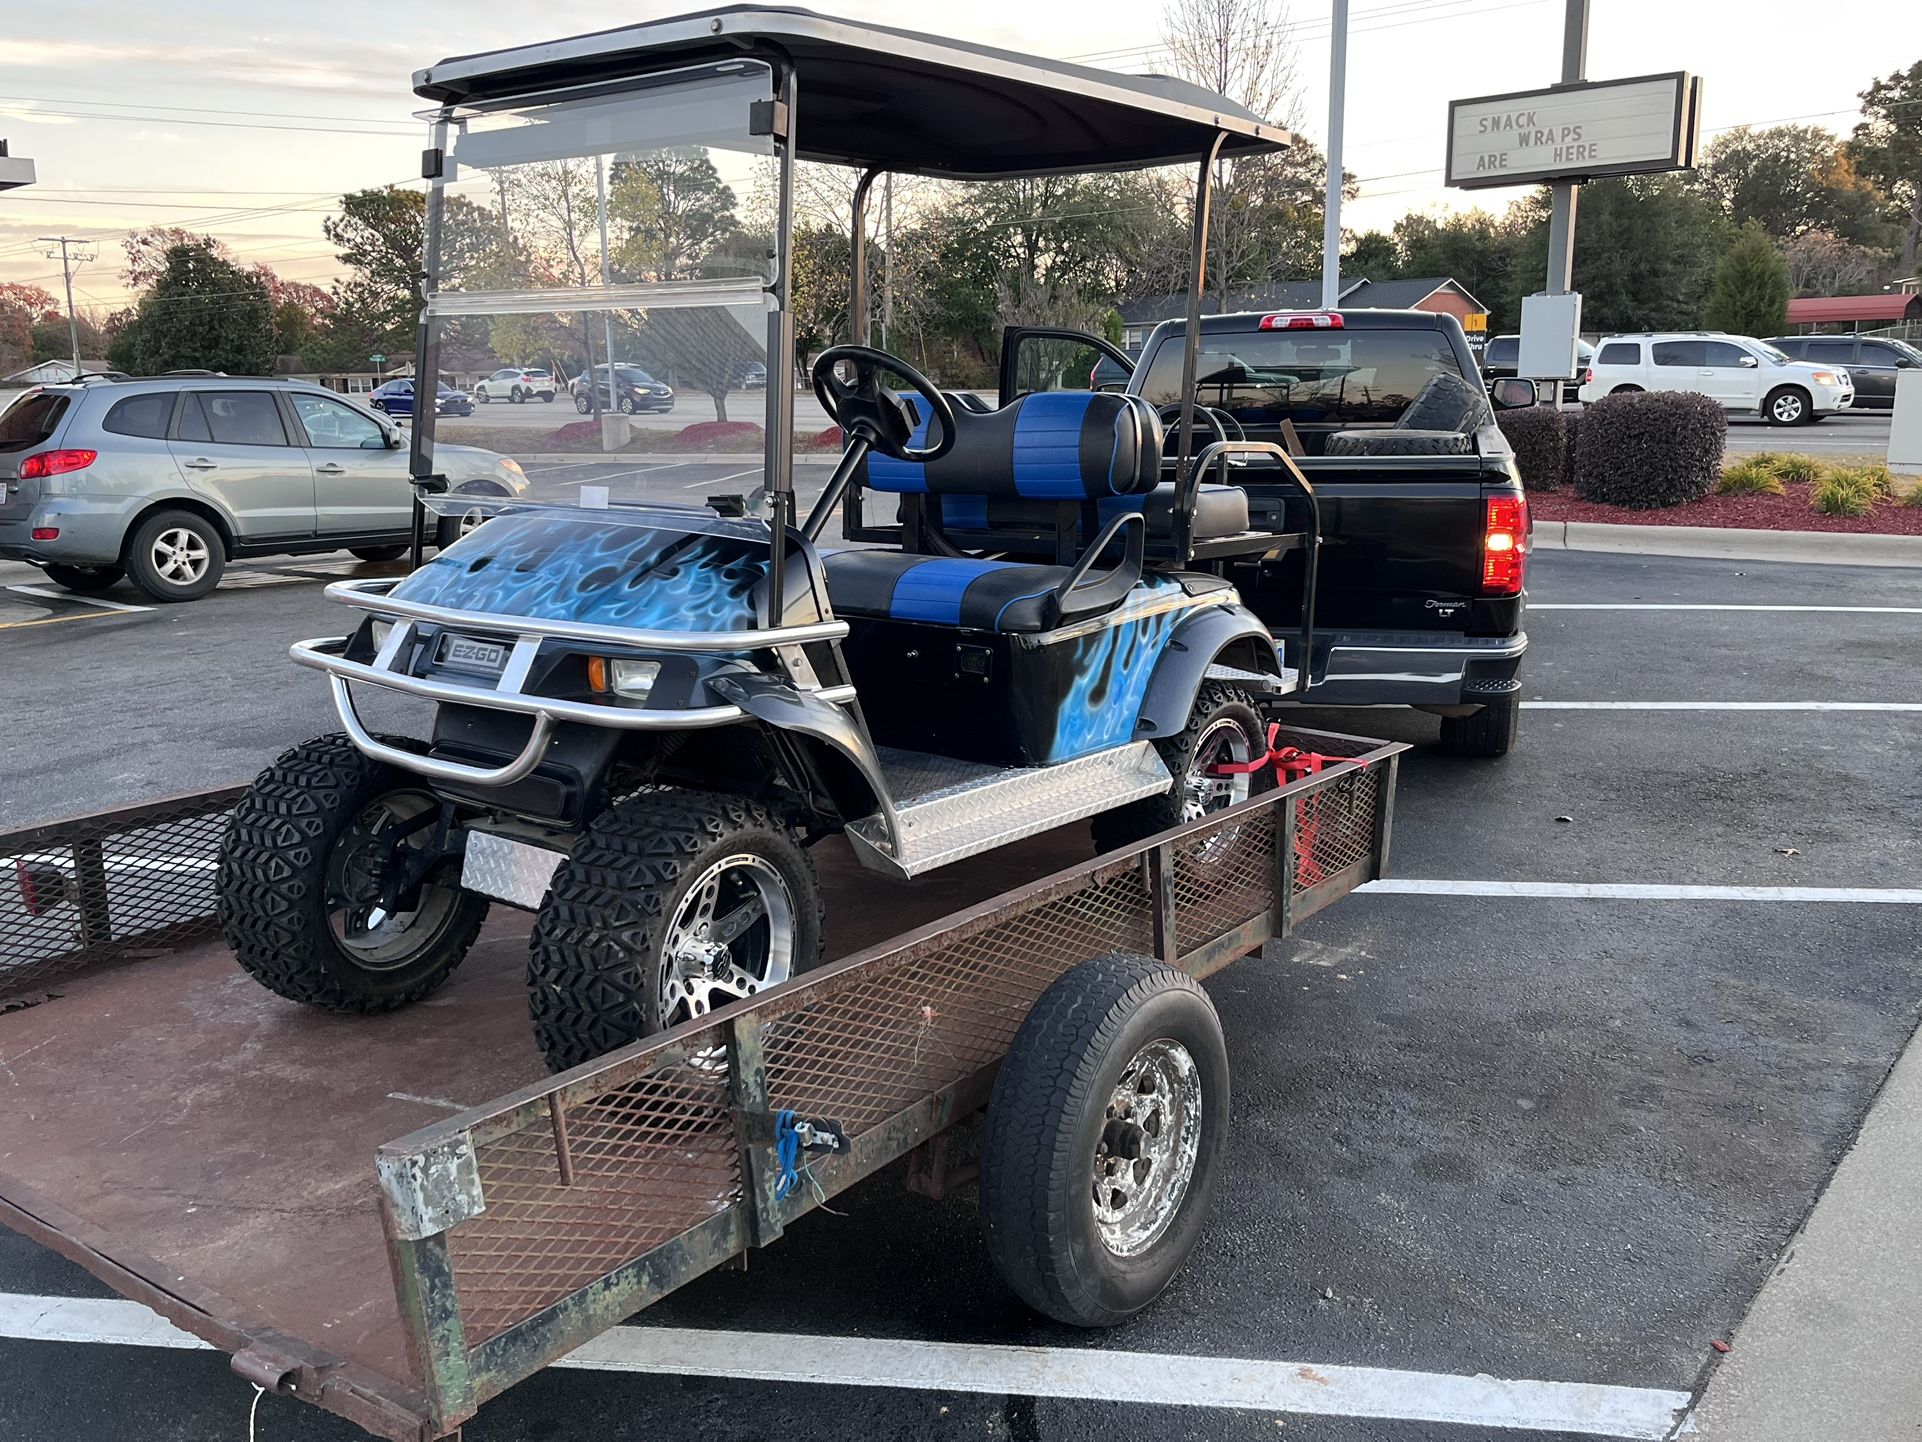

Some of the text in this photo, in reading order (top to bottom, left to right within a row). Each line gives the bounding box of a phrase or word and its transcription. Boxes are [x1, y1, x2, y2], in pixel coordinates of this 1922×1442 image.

[1479, 111, 1536, 134] SNACK
[1518, 126, 1582, 147] WRAPS
[1477, 143, 1597, 170] ARE HERE
[1438, 608, 1455, 617] LT
